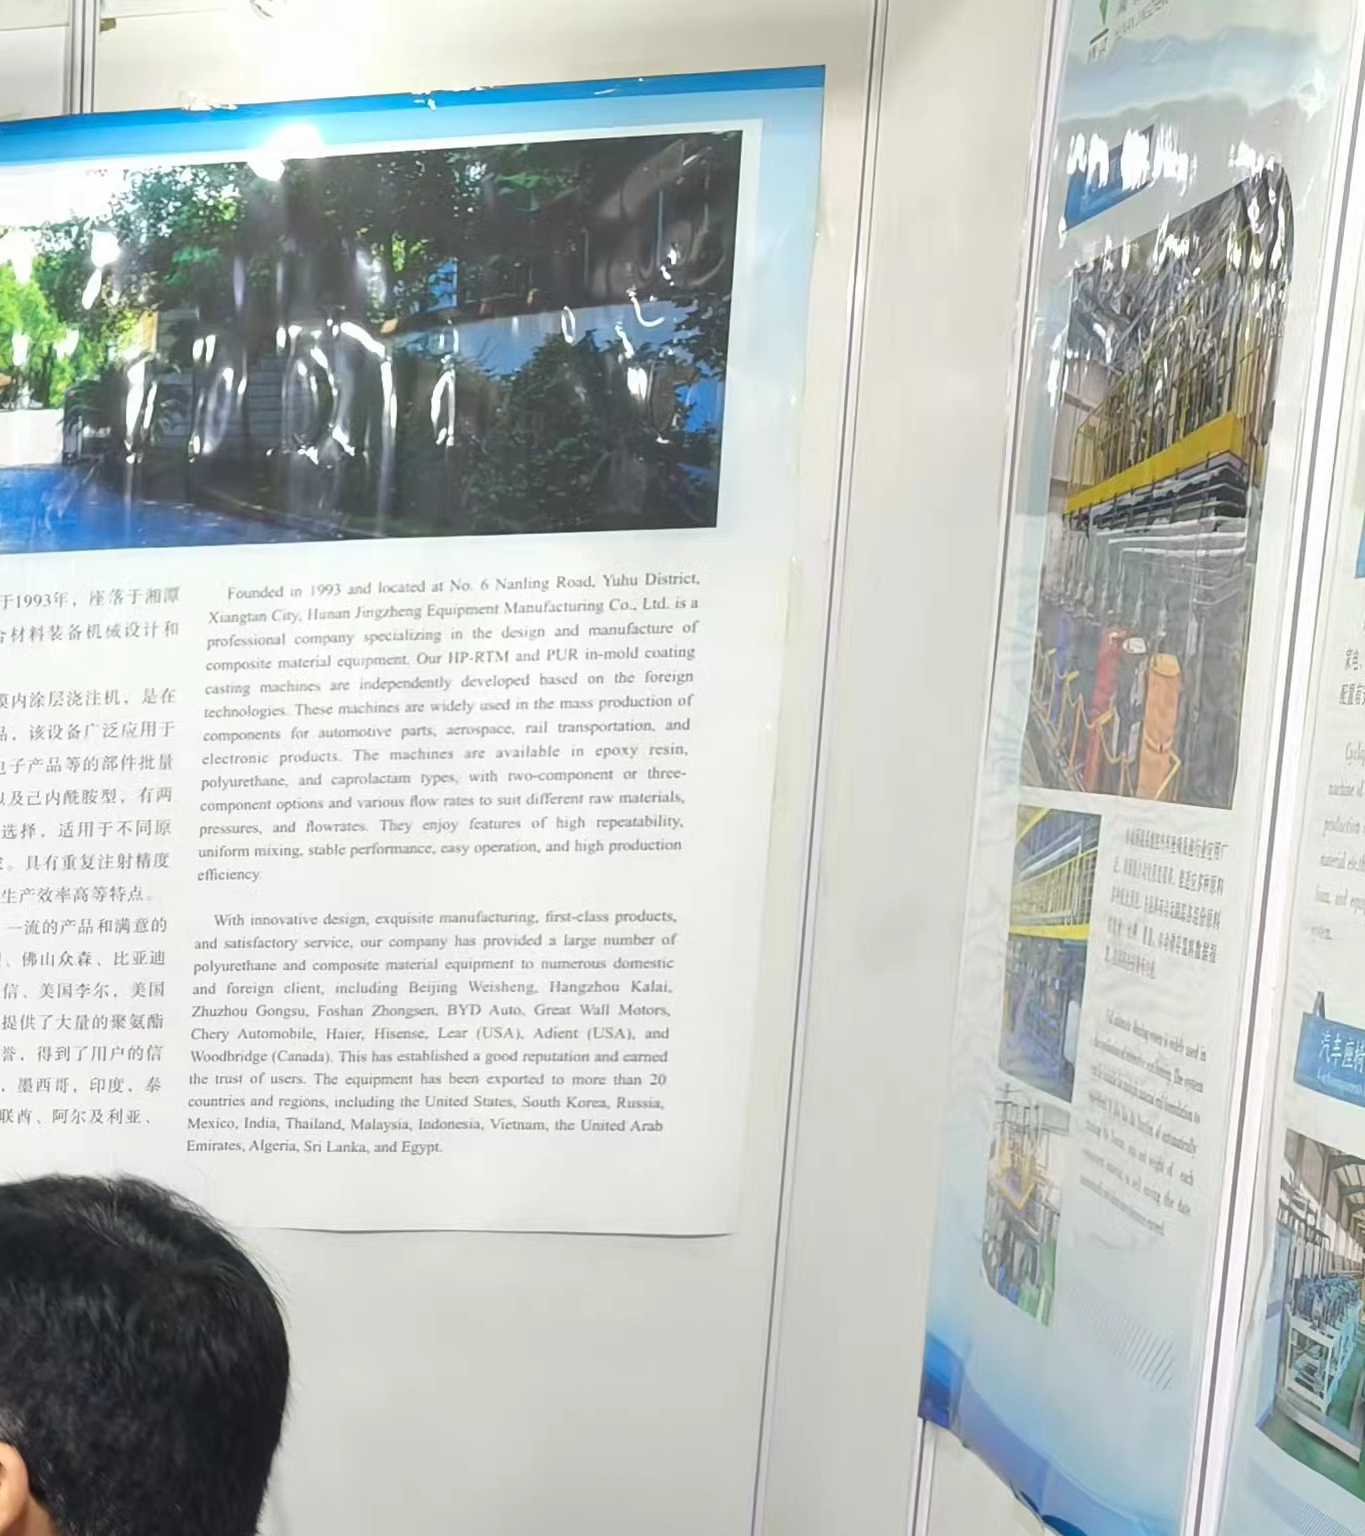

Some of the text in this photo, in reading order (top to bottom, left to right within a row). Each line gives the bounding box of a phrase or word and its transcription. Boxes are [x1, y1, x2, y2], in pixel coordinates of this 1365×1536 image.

[227, 585, 283, 600] Founded
[290, 588, 302, 597] in
[311, 582, 341, 596] 1993
[346, 581, 371, 595] and
[378, 579, 425, 593] located
[430, 581, 443, 592] at
[480, 578, 489, 590] 6
[495, 576, 549, 592] Nanling
[602, 572, 638, 587] Yuhu
[206, 619, 700, 651] professional company specializing in the design and manufacture of
[204, 669, 693, 697] casting machines are independently developed based on the foreign
[193, 956, 674, 975] polyurethane and composite material equipment to numerous domestic
[191, 1004, 247, 1017] Zhuzhou
[317, 1004, 363, 1017] Foshan
[447, 1003, 481, 1016] BYD
[533, 1003, 571, 1015] Great
[578, 1003, 609, 1015] Wall
[554, 1118, 575, 1130] the
[580, 1118, 625, 1131] United
[629, 1119, 663, 1132] Arab
